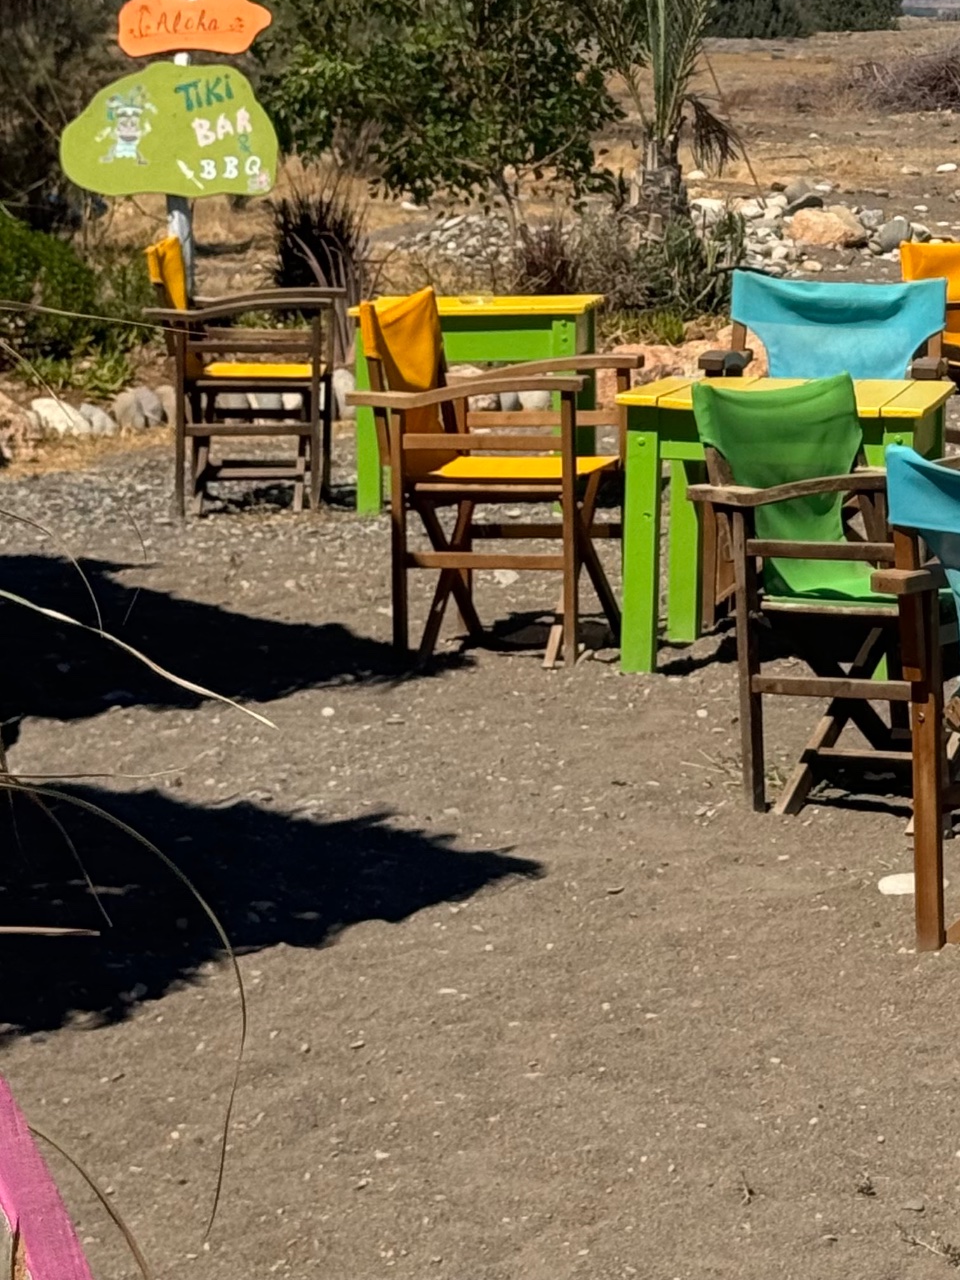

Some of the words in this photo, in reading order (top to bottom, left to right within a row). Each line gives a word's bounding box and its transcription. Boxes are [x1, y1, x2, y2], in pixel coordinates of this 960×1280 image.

[156, 9, 220, 34] Aloha
[191, 106, 253, 148] BAR
[199, 155, 262, 180] BBQ
